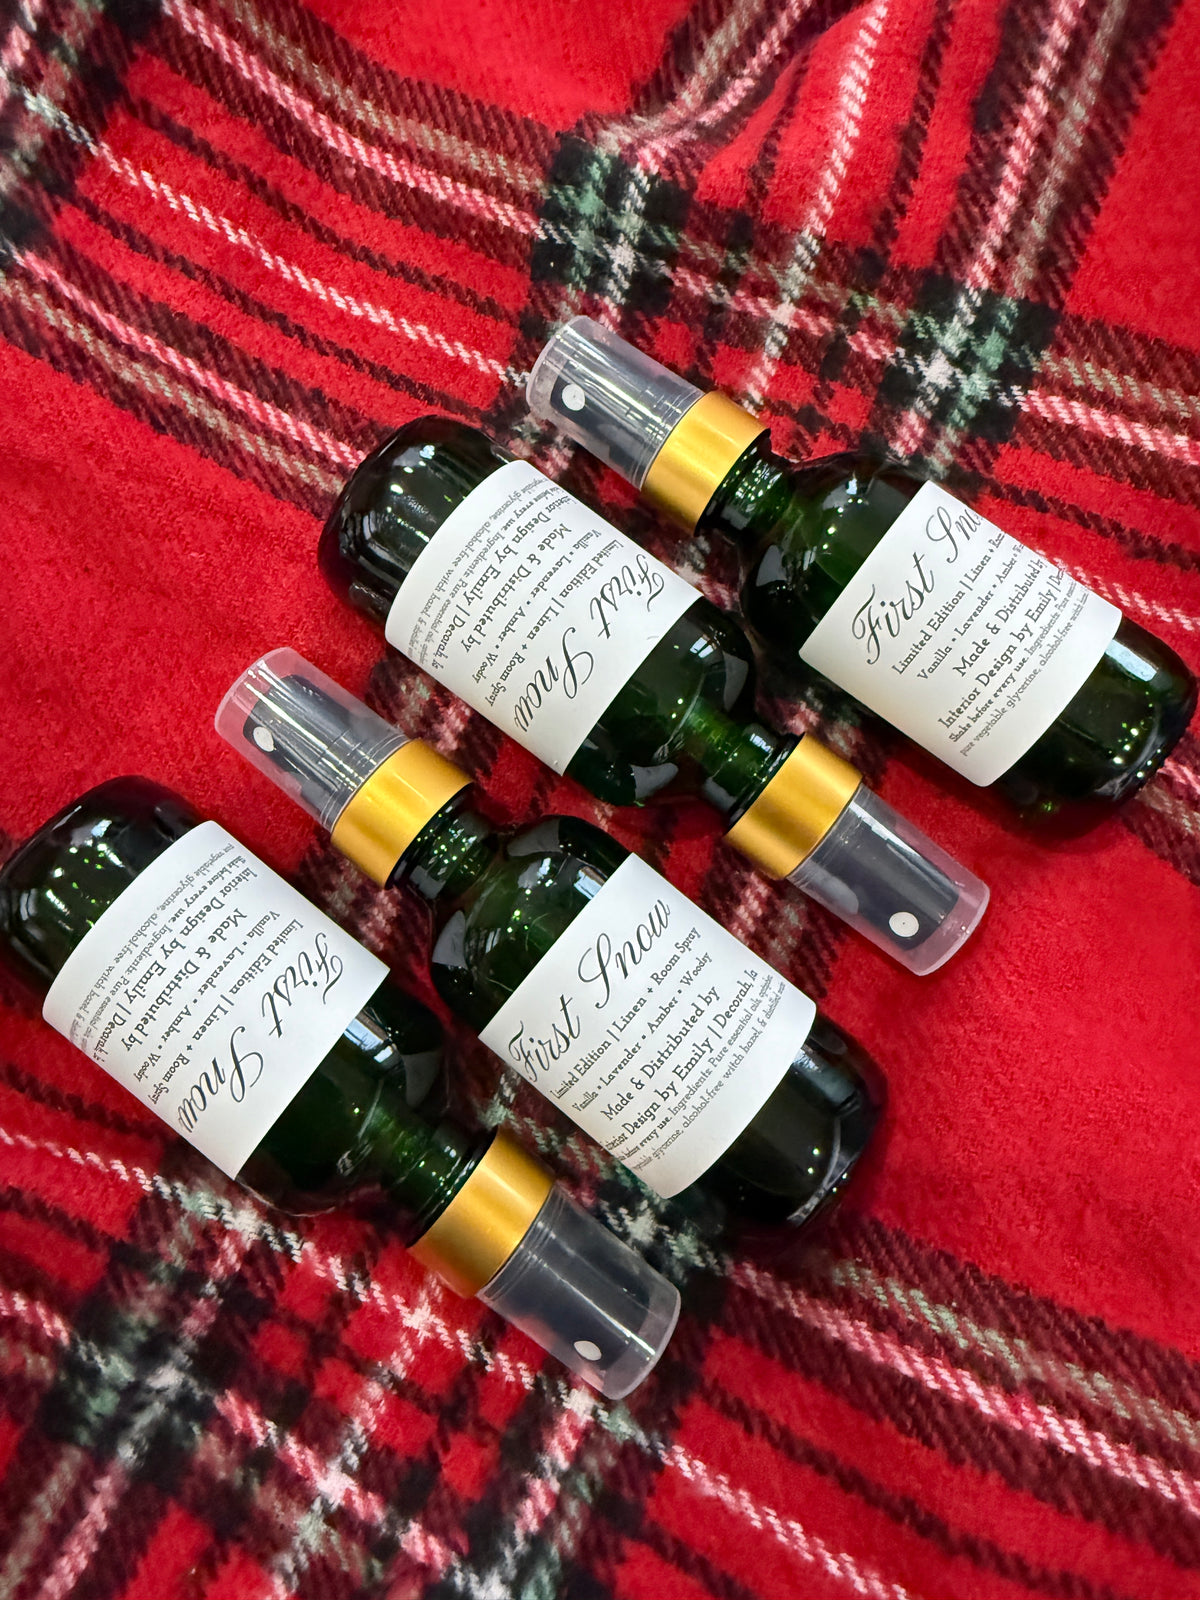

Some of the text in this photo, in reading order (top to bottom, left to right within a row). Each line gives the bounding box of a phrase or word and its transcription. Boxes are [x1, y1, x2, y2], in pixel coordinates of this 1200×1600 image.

[451, 520, 491, 567] alcohol-free
[511, 511, 551, 544] Design
[537, 522, 572, 551] Made
[494, 543, 519, 564] by
[526, 553, 541, 566] &
[434, 568, 454, 593] witch
[448, 577, 468, 599] Pure
[462, 563, 501, 606] Emily
[530, 554, 572, 598] Lavender
[558, 562, 598, 598] Edition
[472, 563, 532, 637] Distributed
[851, 551, 935, 665] First
[891, 629, 933, 675] Limited
[926, 590, 966, 632] Edition
[963, 554, 992, 583] Linen
[916, 645, 953, 679] Vanilla
[953, 590, 994, 637] Lavender
[994, 557, 1017, 584] Amber
[952, 638, 991, 677] Made
[985, 622, 1001, 635] &
[994, 563, 1041, 623] Distributed
[432, 613, 466, 659] Decorah,
[460, 633, 481, 653] by
[497, 605, 526, 642] Amber
[513, 553, 665, 732] First Snow
[526, 605, 560, 640] Linen
[471, 652, 499, 684] Woodsy
[499, 651, 526, 682] Room
[937, 687, 981, 729] Interior
[974, 644, 1018, 687] Design
[1009, 622, 1034, 643] by
[1024, 588, 1058, 623] Emily
[484, 681, 507, 707] Spray
[948, 722, 972, 742] Shake
[966, 698, 994, 723] before
[992, 672, 1016, 698] every
[1013, 656, 1029, 672] use.
[972, 707, 1008, 741] vegetable
[1005, 668, 1042, 709] glycerine,
[1038, 621, 1073, 667] alcohol-free
[156, 873, 195, 911] glycerine,
[183, 884, 208, 908] every
[218, 866, 258, 898] Interior
[167, 907, 186, 923] use.
[179, 896, 225, 936] Design
[113, 912, 158, 964] alcohol-free
[124, 923, 173, 975] Ingredients:
[159, 937, 187, 960] by
[265, 918, 304, 956] Limited
[93, 965, 115, 990] witch
[109, 974, 130, 996] Pure
[120, 907, 248, 1052] Made & Distributed by
[123, 959, 167, 1005] Emily
[228, 952, 272, 995] Edition
[508, 899, 671, 1082] First Snow
[133, 910, 280, 1082] Vanilla Lavender Amber Woodsy
[572, 1040, 612, 1077] Edition
[611, 997, 647, 1033] Linen
[649, 953, 681, 986] Room
[673, 926, 701, 954] Spray
[177, 932, 343, 1133] First Snow
[191, 1003, 229, 1041] Linen
[599, 1041, 642, 1086] Lavender
[646, 996, 678, 1034] Amber
[679, 951, 712, 986] Woodsy
[707, 1046, 729, 1068] Pure
[726, 1008, 753, 1046] essential
[161, 1052, 190, 1083] Room
[599, 1091, 634, 1121] Made
[629, 1076, 645, 1091] &
[639, 1002, 705, 1080] Distributed
[696, 986, 720, 1006] by
[621, 1101, 661, 1135] Design
[653, 1080, 679, 1102] by
[671, 1036, 714, 1082] Emily
[712, 980, 754, 1029] Decorah,
[681, 1079, 724, 1128] alcohol-free
[722, 1052, 745, 1079] witch
